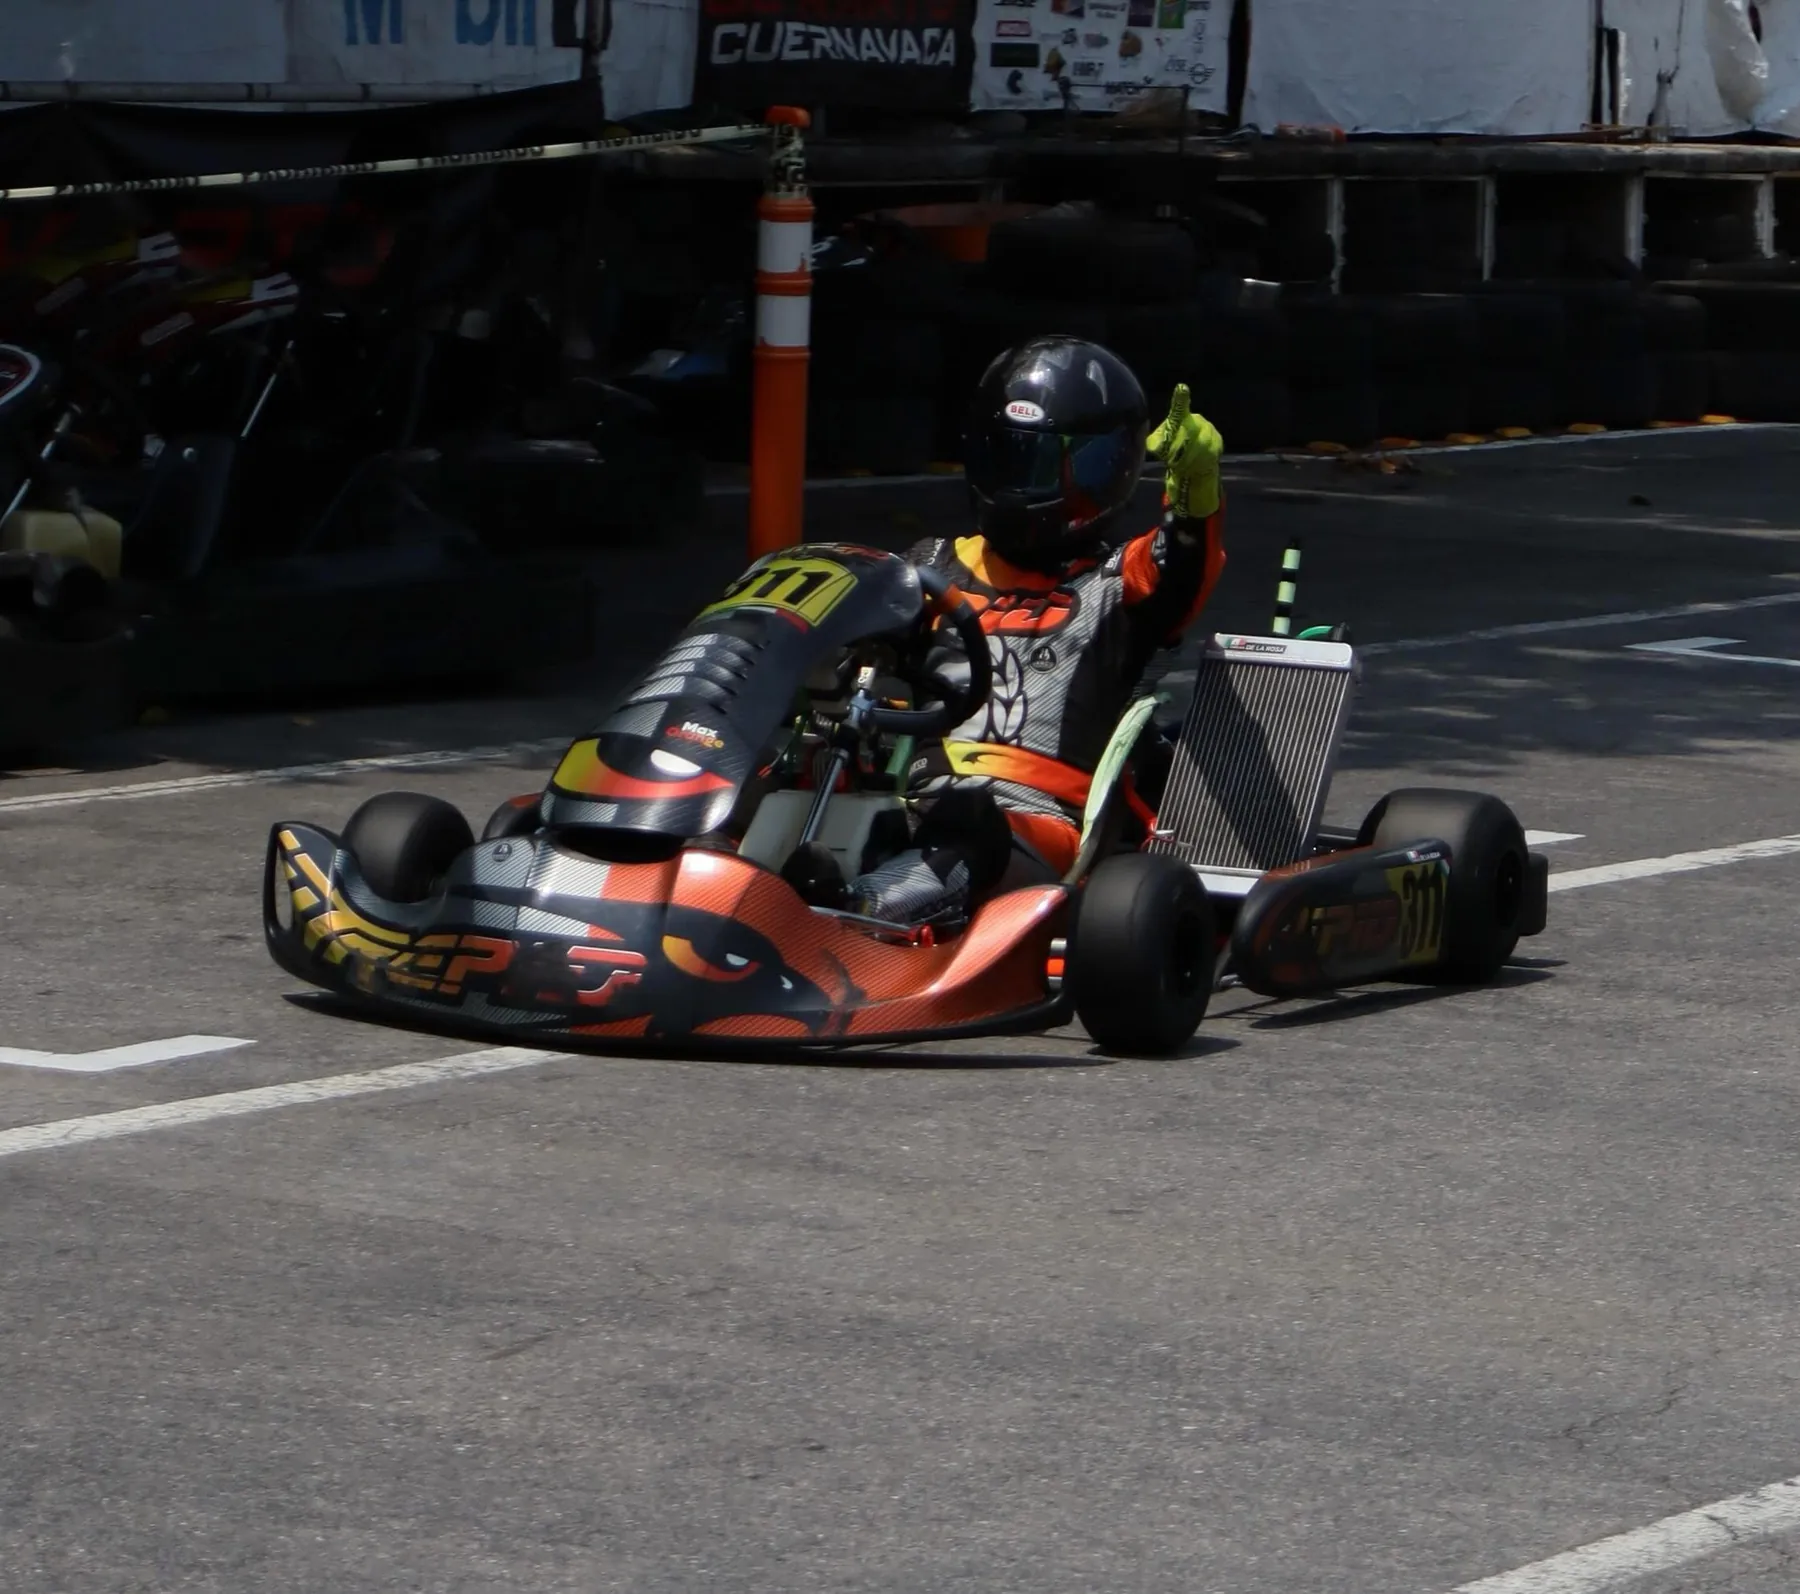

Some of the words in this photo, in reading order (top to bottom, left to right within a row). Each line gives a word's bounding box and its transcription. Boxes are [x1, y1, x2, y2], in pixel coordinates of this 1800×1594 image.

[344, 0, 537, 46] Mbil
[709, 21, 957, 67] CUERNAVACA
[1010, 405, 1039, 418] BELL
[681, 721, 718, 738] Max
[1400, 859, 1443, 960] 311
